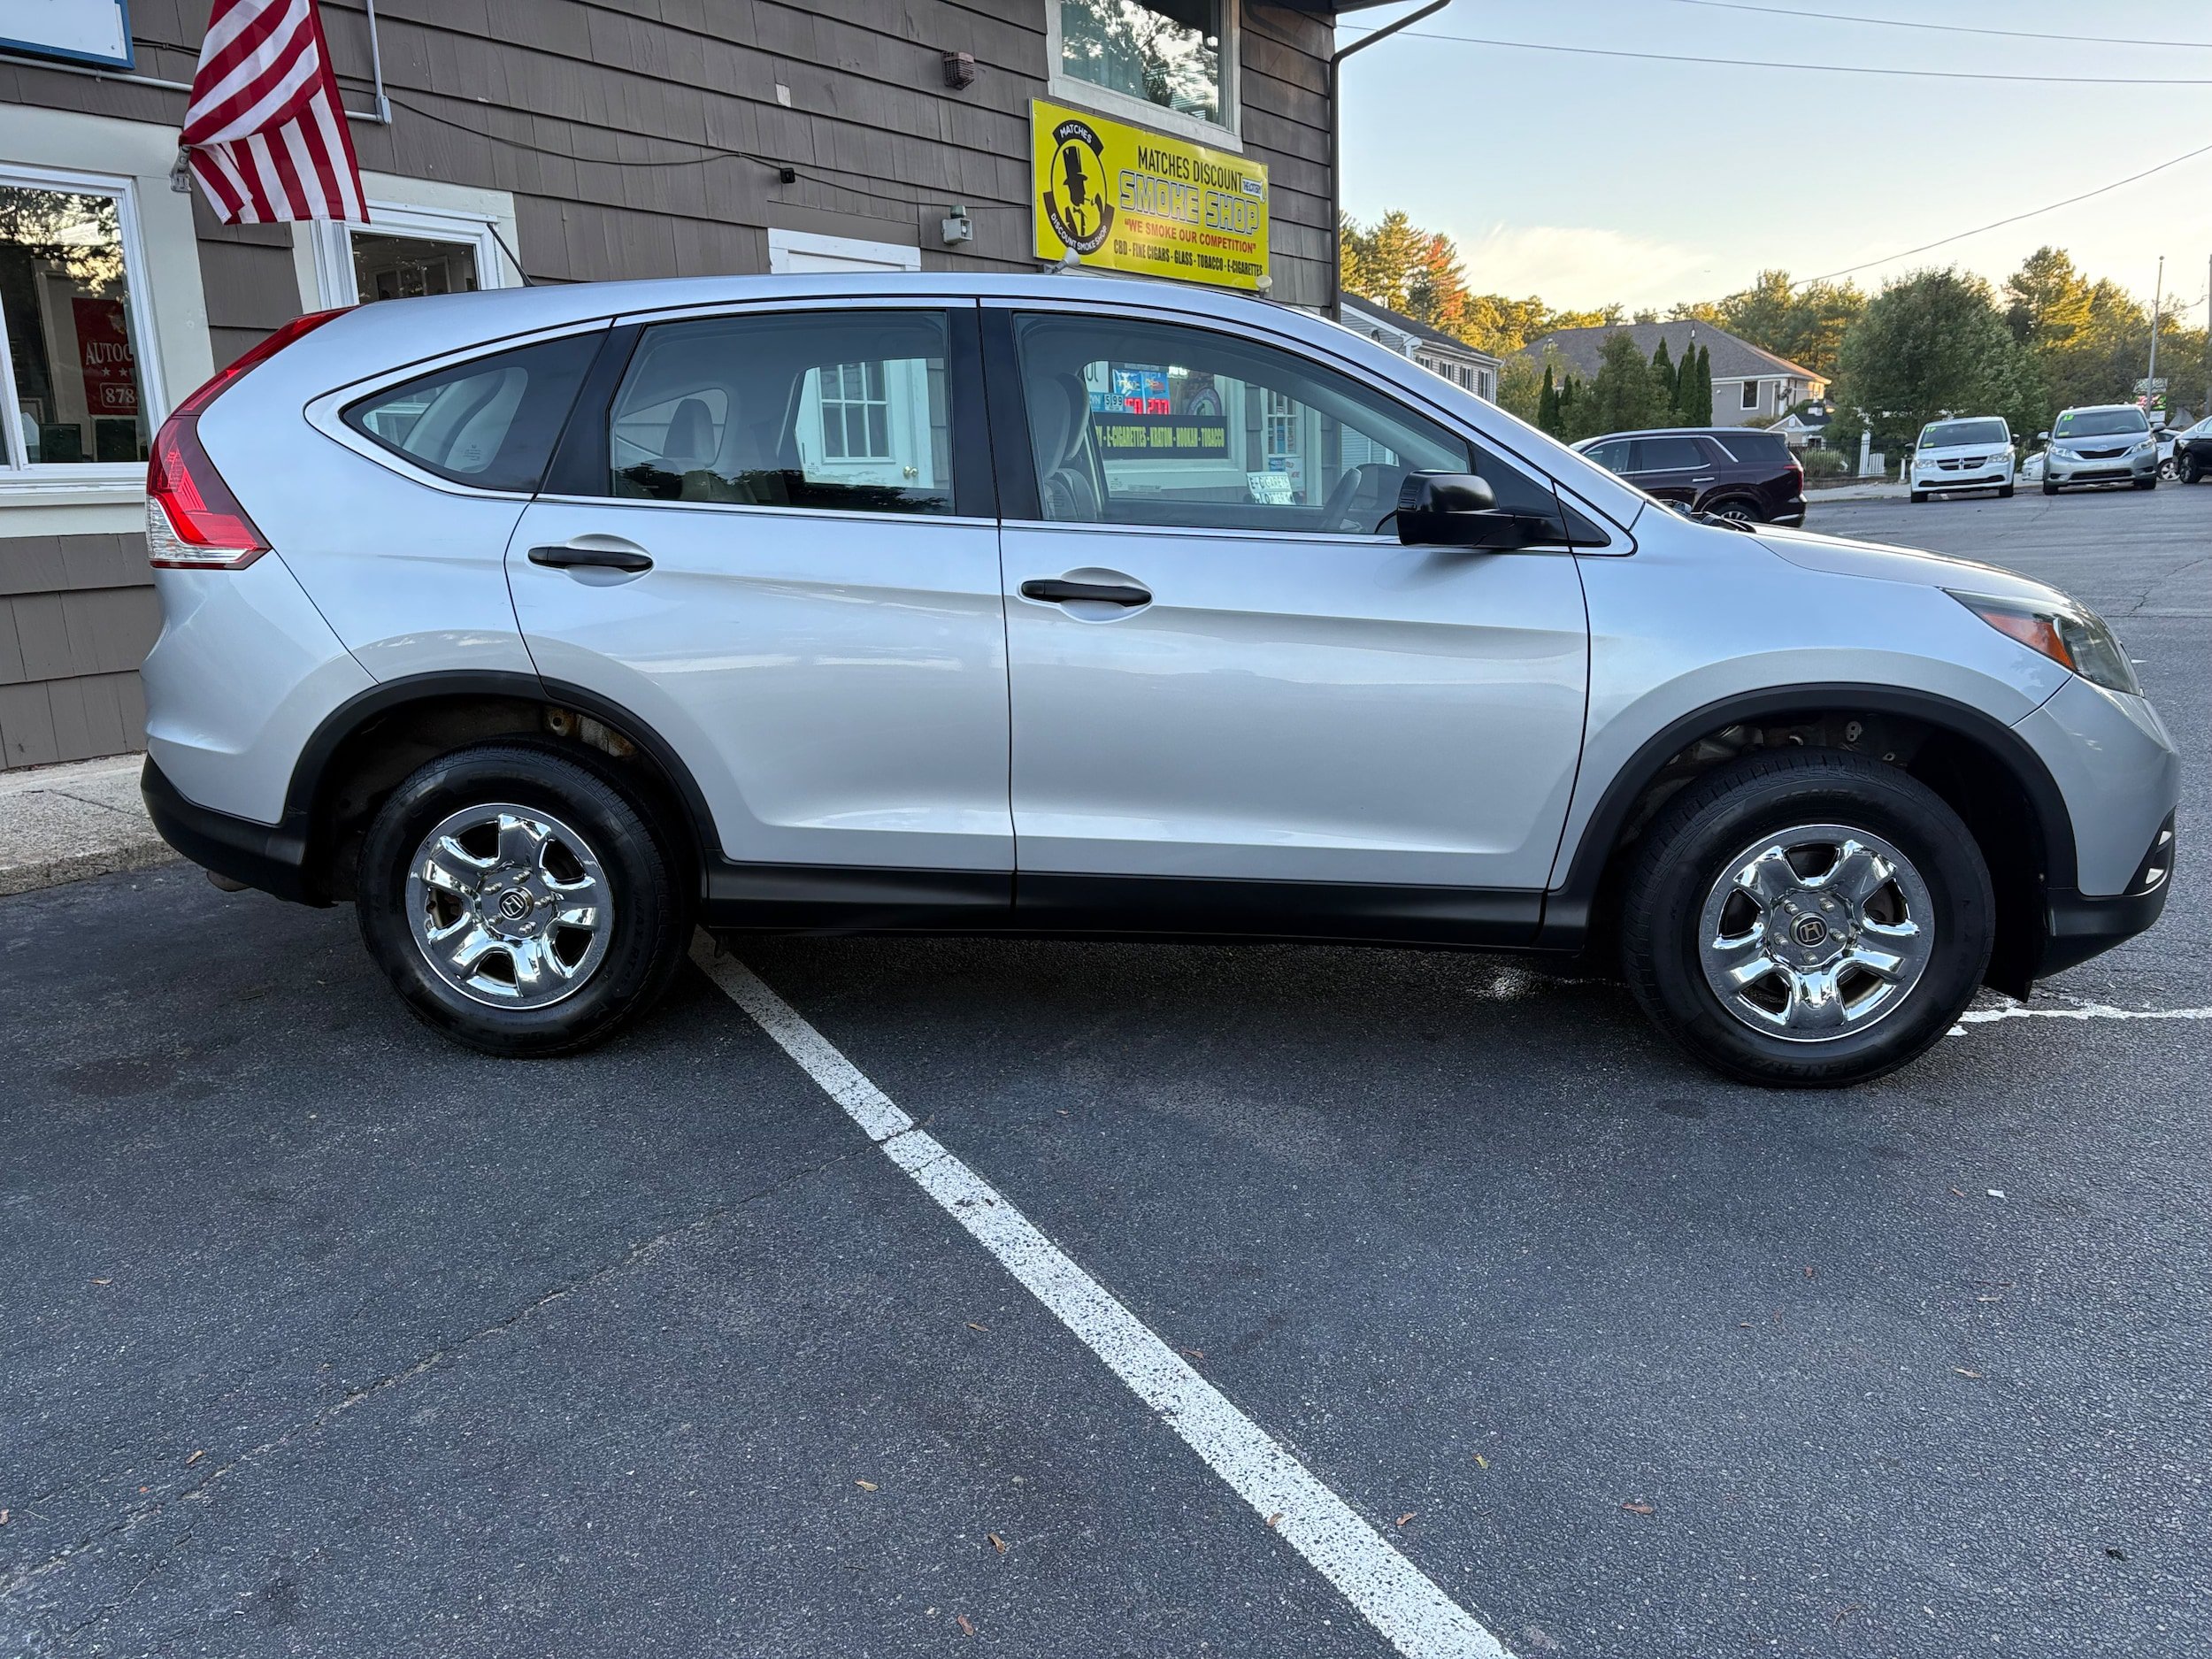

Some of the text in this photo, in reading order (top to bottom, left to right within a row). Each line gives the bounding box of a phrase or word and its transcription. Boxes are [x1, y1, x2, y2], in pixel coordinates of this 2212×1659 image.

[1060, 124, 1093, 144] MATCHES
[1138, 145, 1190, 180] MATCHES
[1193, 160, 1243, 194] DISCOUNT
[1118, 168, 1261, 235] SMOKE SHOP
[1050, 212, 1107, 251] DISCOUNT SMOKE SHOP
[1145, 221, 1177, 241] SMOKE
[1179, 228, 1197, 244] OUR
[1114, 239, 1263, 277] CBD FINE CIGARS GLASS TOBACCO E-CIGARETTES
